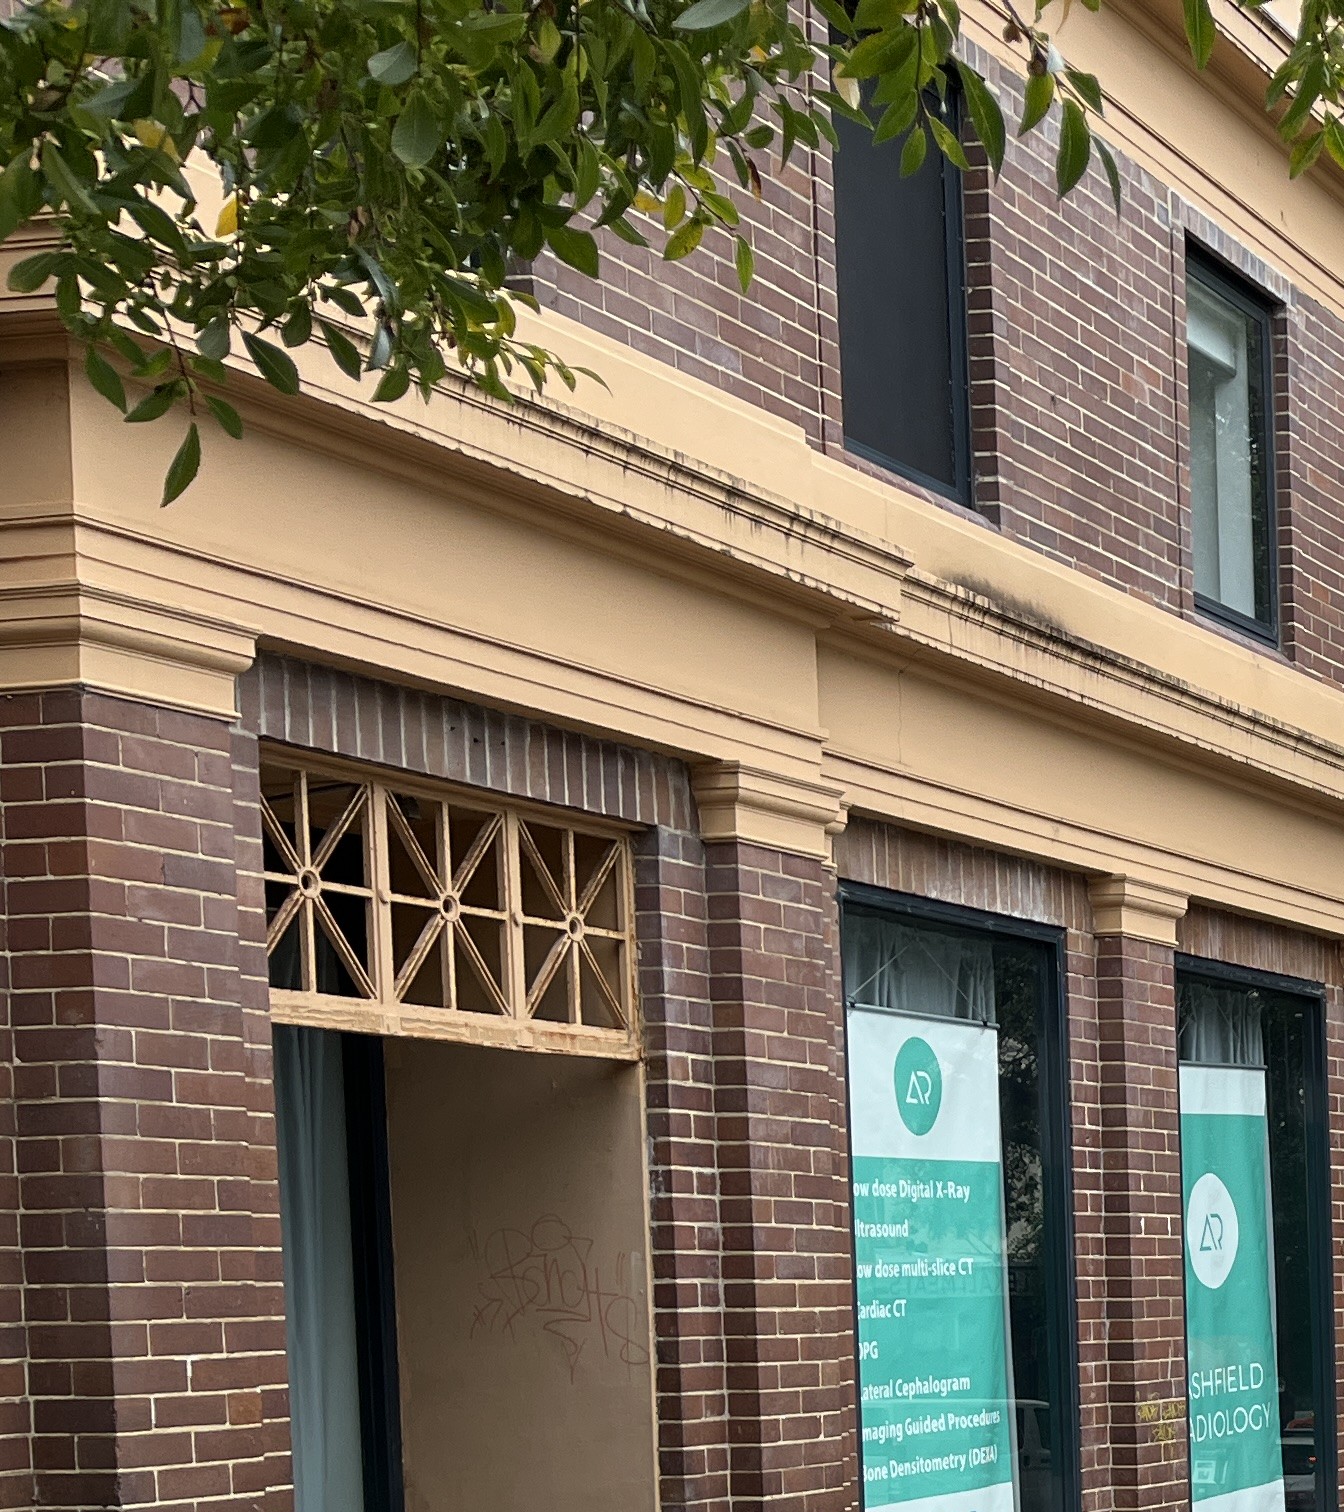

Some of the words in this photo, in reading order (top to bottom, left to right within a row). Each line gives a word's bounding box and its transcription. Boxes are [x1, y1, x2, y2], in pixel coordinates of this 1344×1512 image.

[853, 1182, 869, 1197] ow
[872, 1178, 897, 1197] dose
[899, 1179, 934, 1203] Digital
[935, 1180, 970, 1203] X-Ray
[857, 1263, 872, 1279] ow
[875, 1258, 900, 1278] dose
[902, 1257, 956, 1277] multi-slice
[958, 1257, 974, 1275] CT
[893, 1299, 907, 1317] CT
[860, 1379, 893, 1402] ateral
[895, 1375, 971, 1400] Cephalogram
[862, 1420, 903, 1444] maging
[905, 1412, 946, 1436] Guided
[947, 1408, 1001, 1431] Procedures
[1190, 1402, 1271, 1443] ADIOLOGY
[889, 1453, 966, 1478] Densitometry
